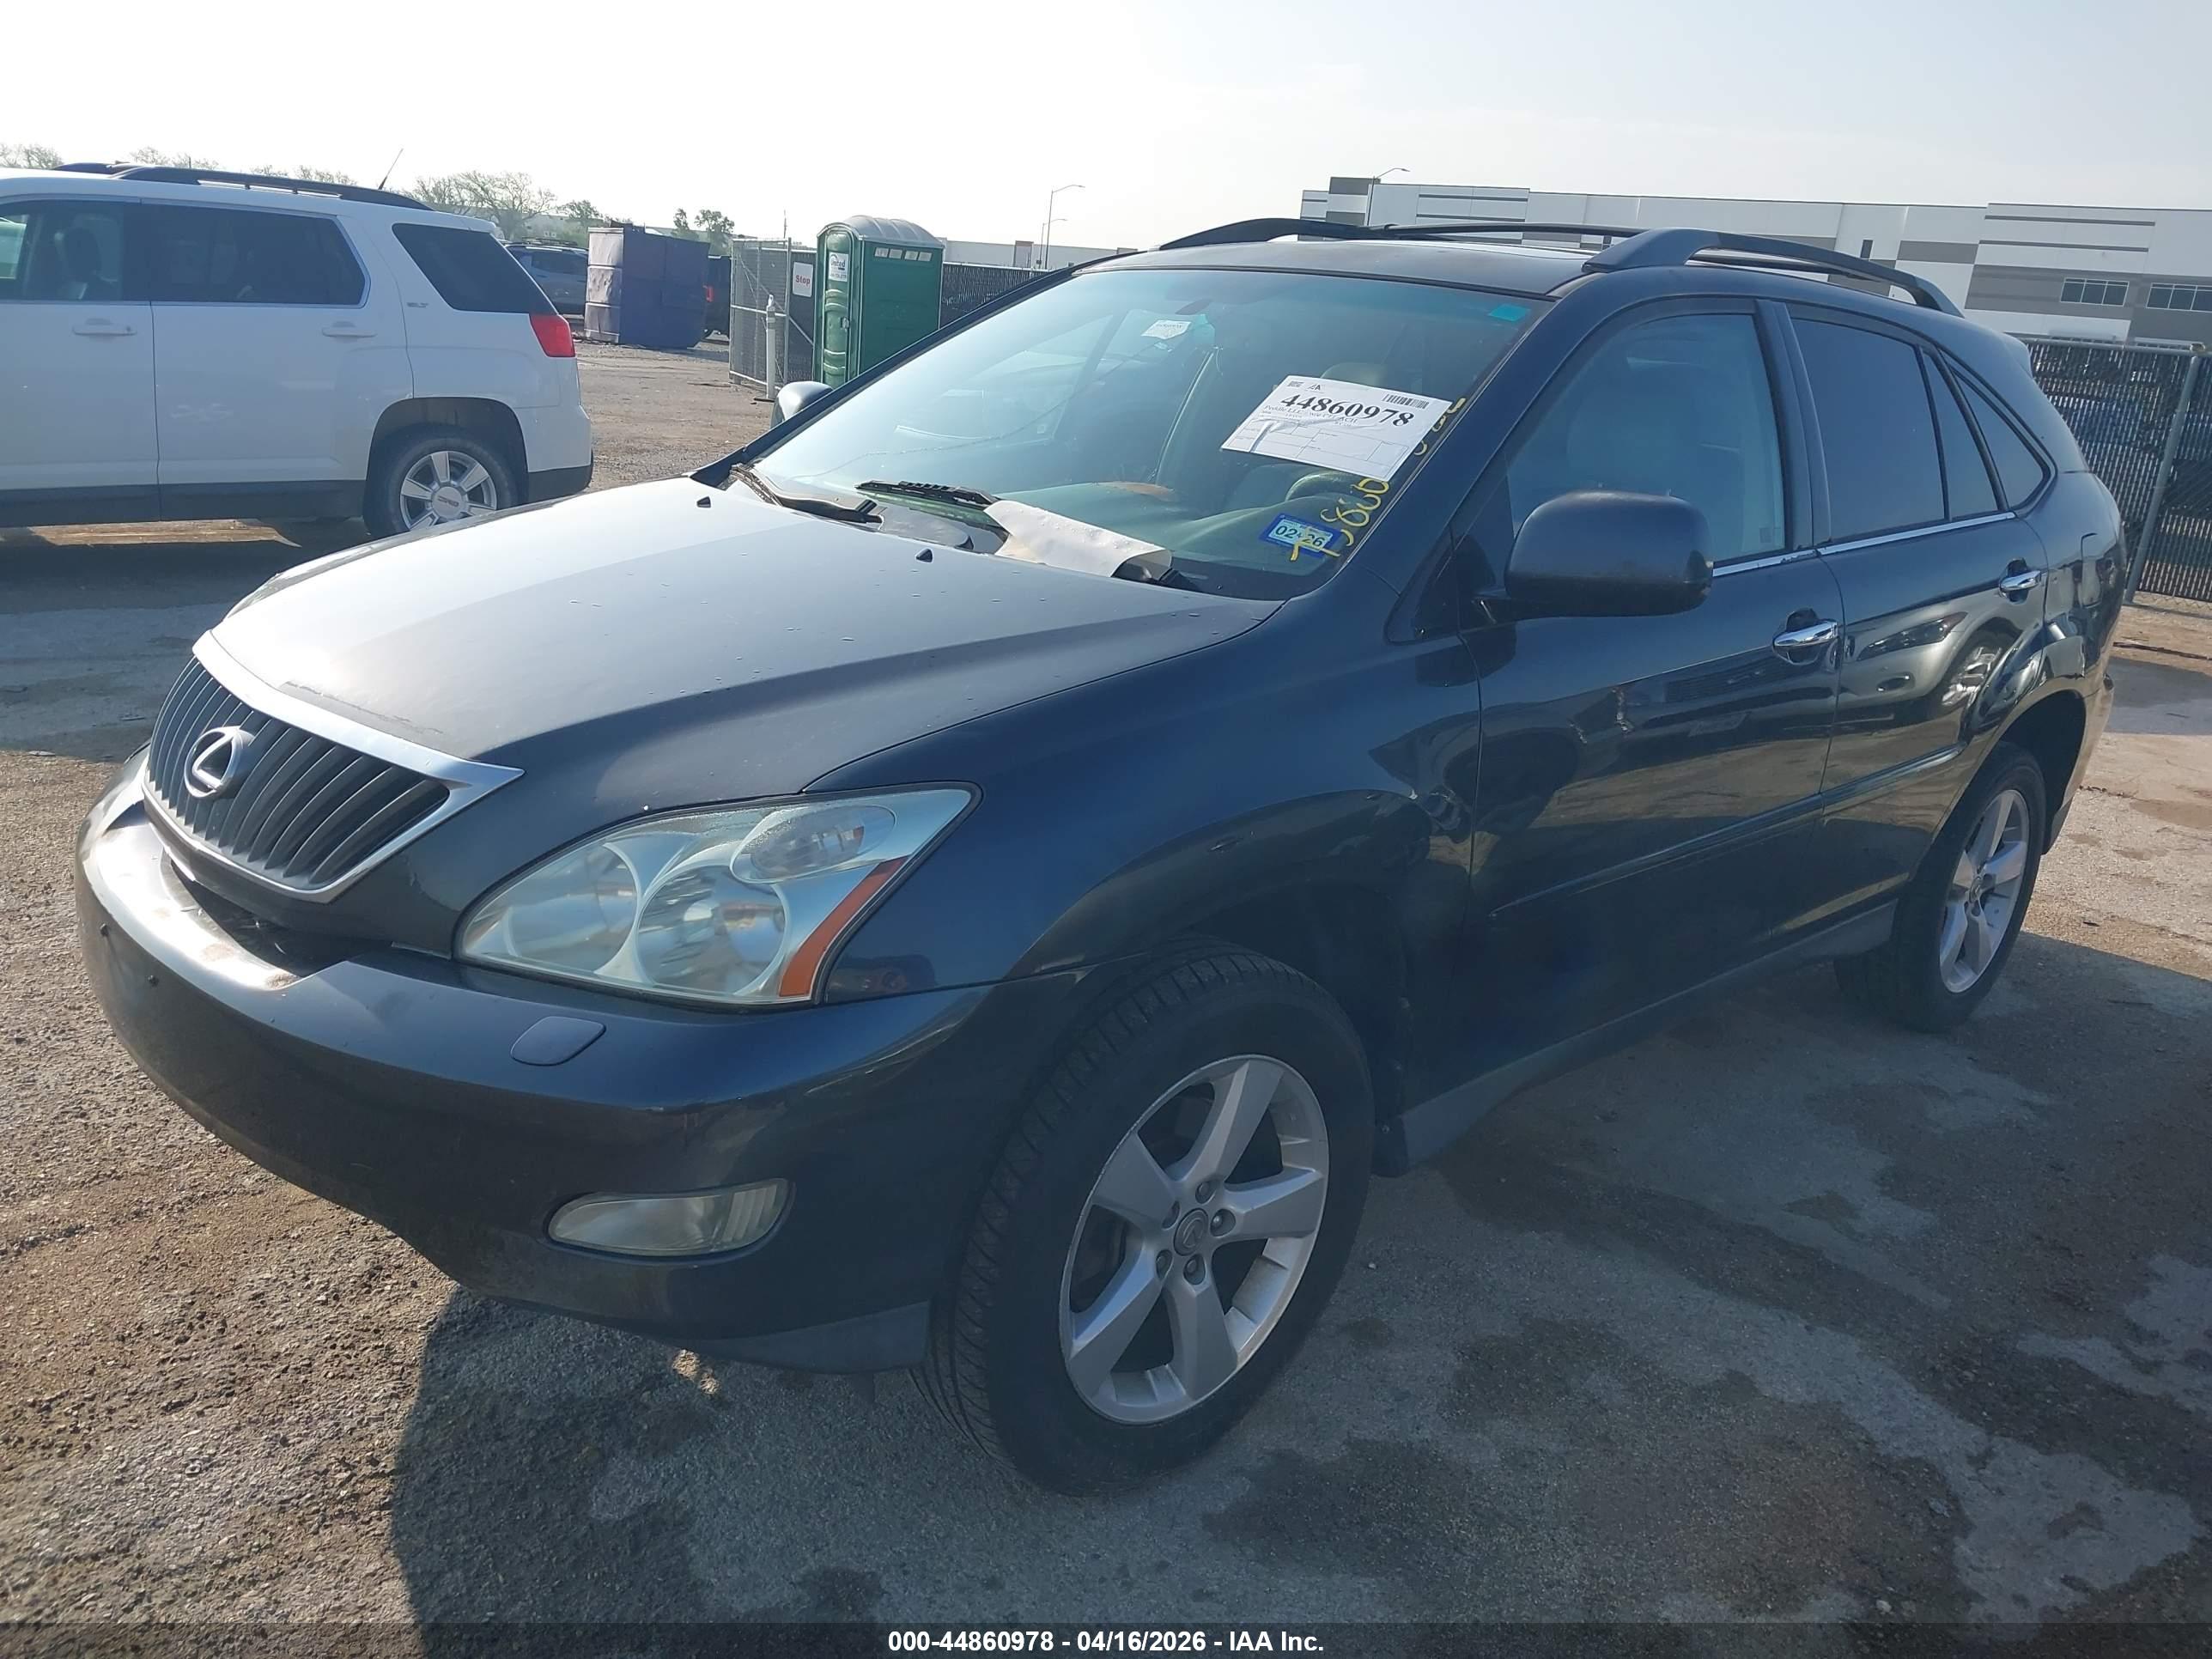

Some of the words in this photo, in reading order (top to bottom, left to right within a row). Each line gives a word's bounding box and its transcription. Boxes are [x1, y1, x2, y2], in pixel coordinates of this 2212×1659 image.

[795, 275, 810, 286] Stop
[1280, 394, 1414, 427] 44860978
[1275, 525, 1297, 539] 02
